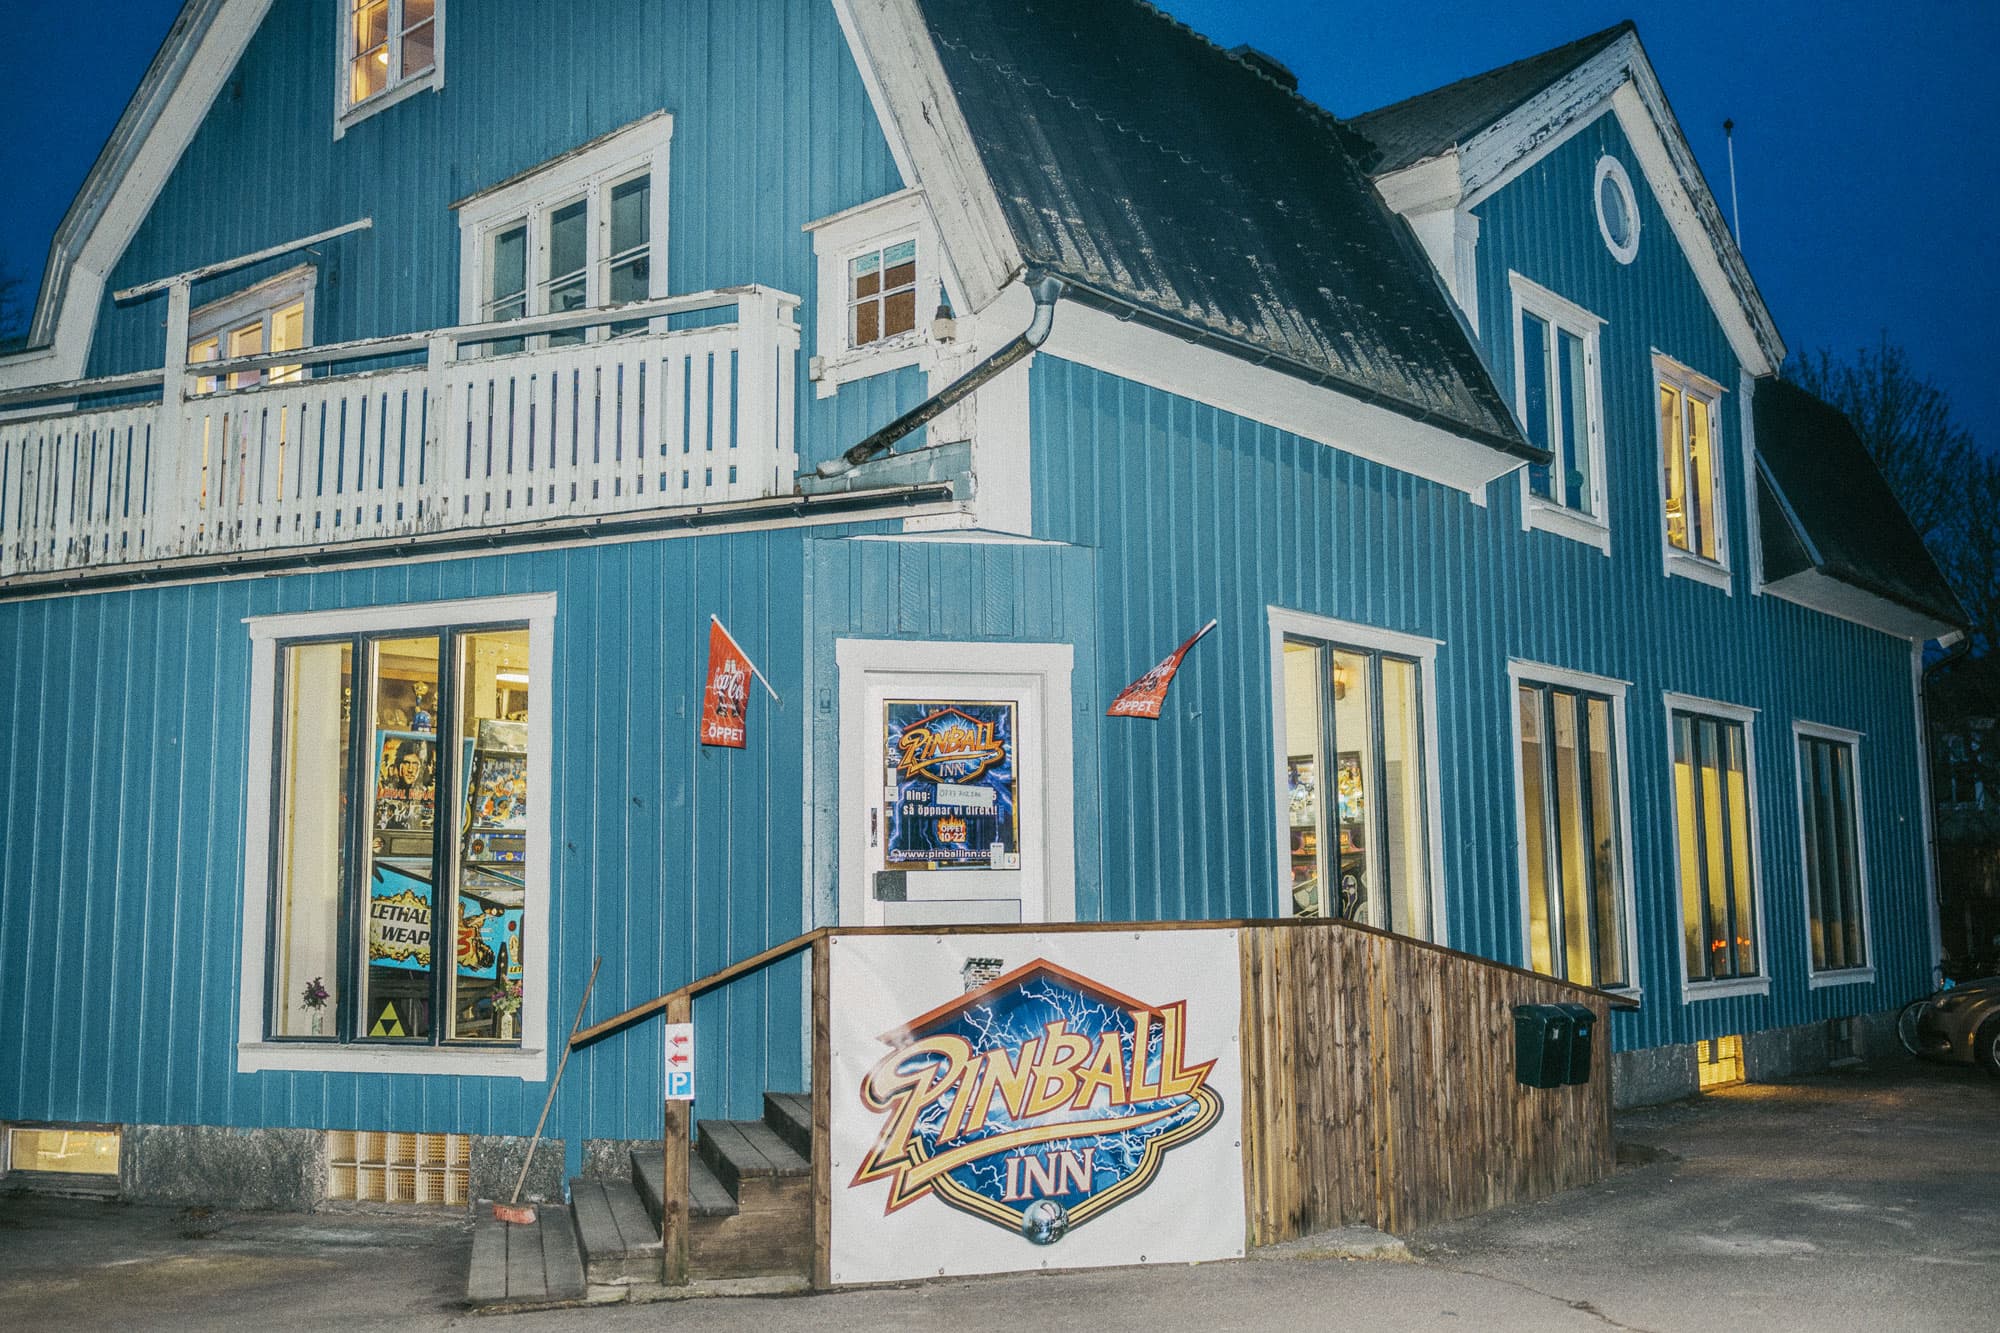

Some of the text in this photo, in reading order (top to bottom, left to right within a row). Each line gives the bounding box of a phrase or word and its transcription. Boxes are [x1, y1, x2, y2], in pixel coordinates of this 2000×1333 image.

[1115, 699, 1154, 712] ÖPPET
[708, 722, 744, 741] ÖPPET
[899, 722, 1002, 769] PINBALL
[939, 763, 966, 777] INN
[918, 804, 951, 817] öppnar
[941, 832, 965, 842] 10-22
[902, 849, 991, 859] www.pinballinn.co
[371, 904, 428, 925] LETHAL
[381, 925, 430, 945] WEAP
[672, 1072, 688, 1094] P
[856, 1000, 1218, 1176] PINBALL
[1001, 1148, 1096, 1202] INN
